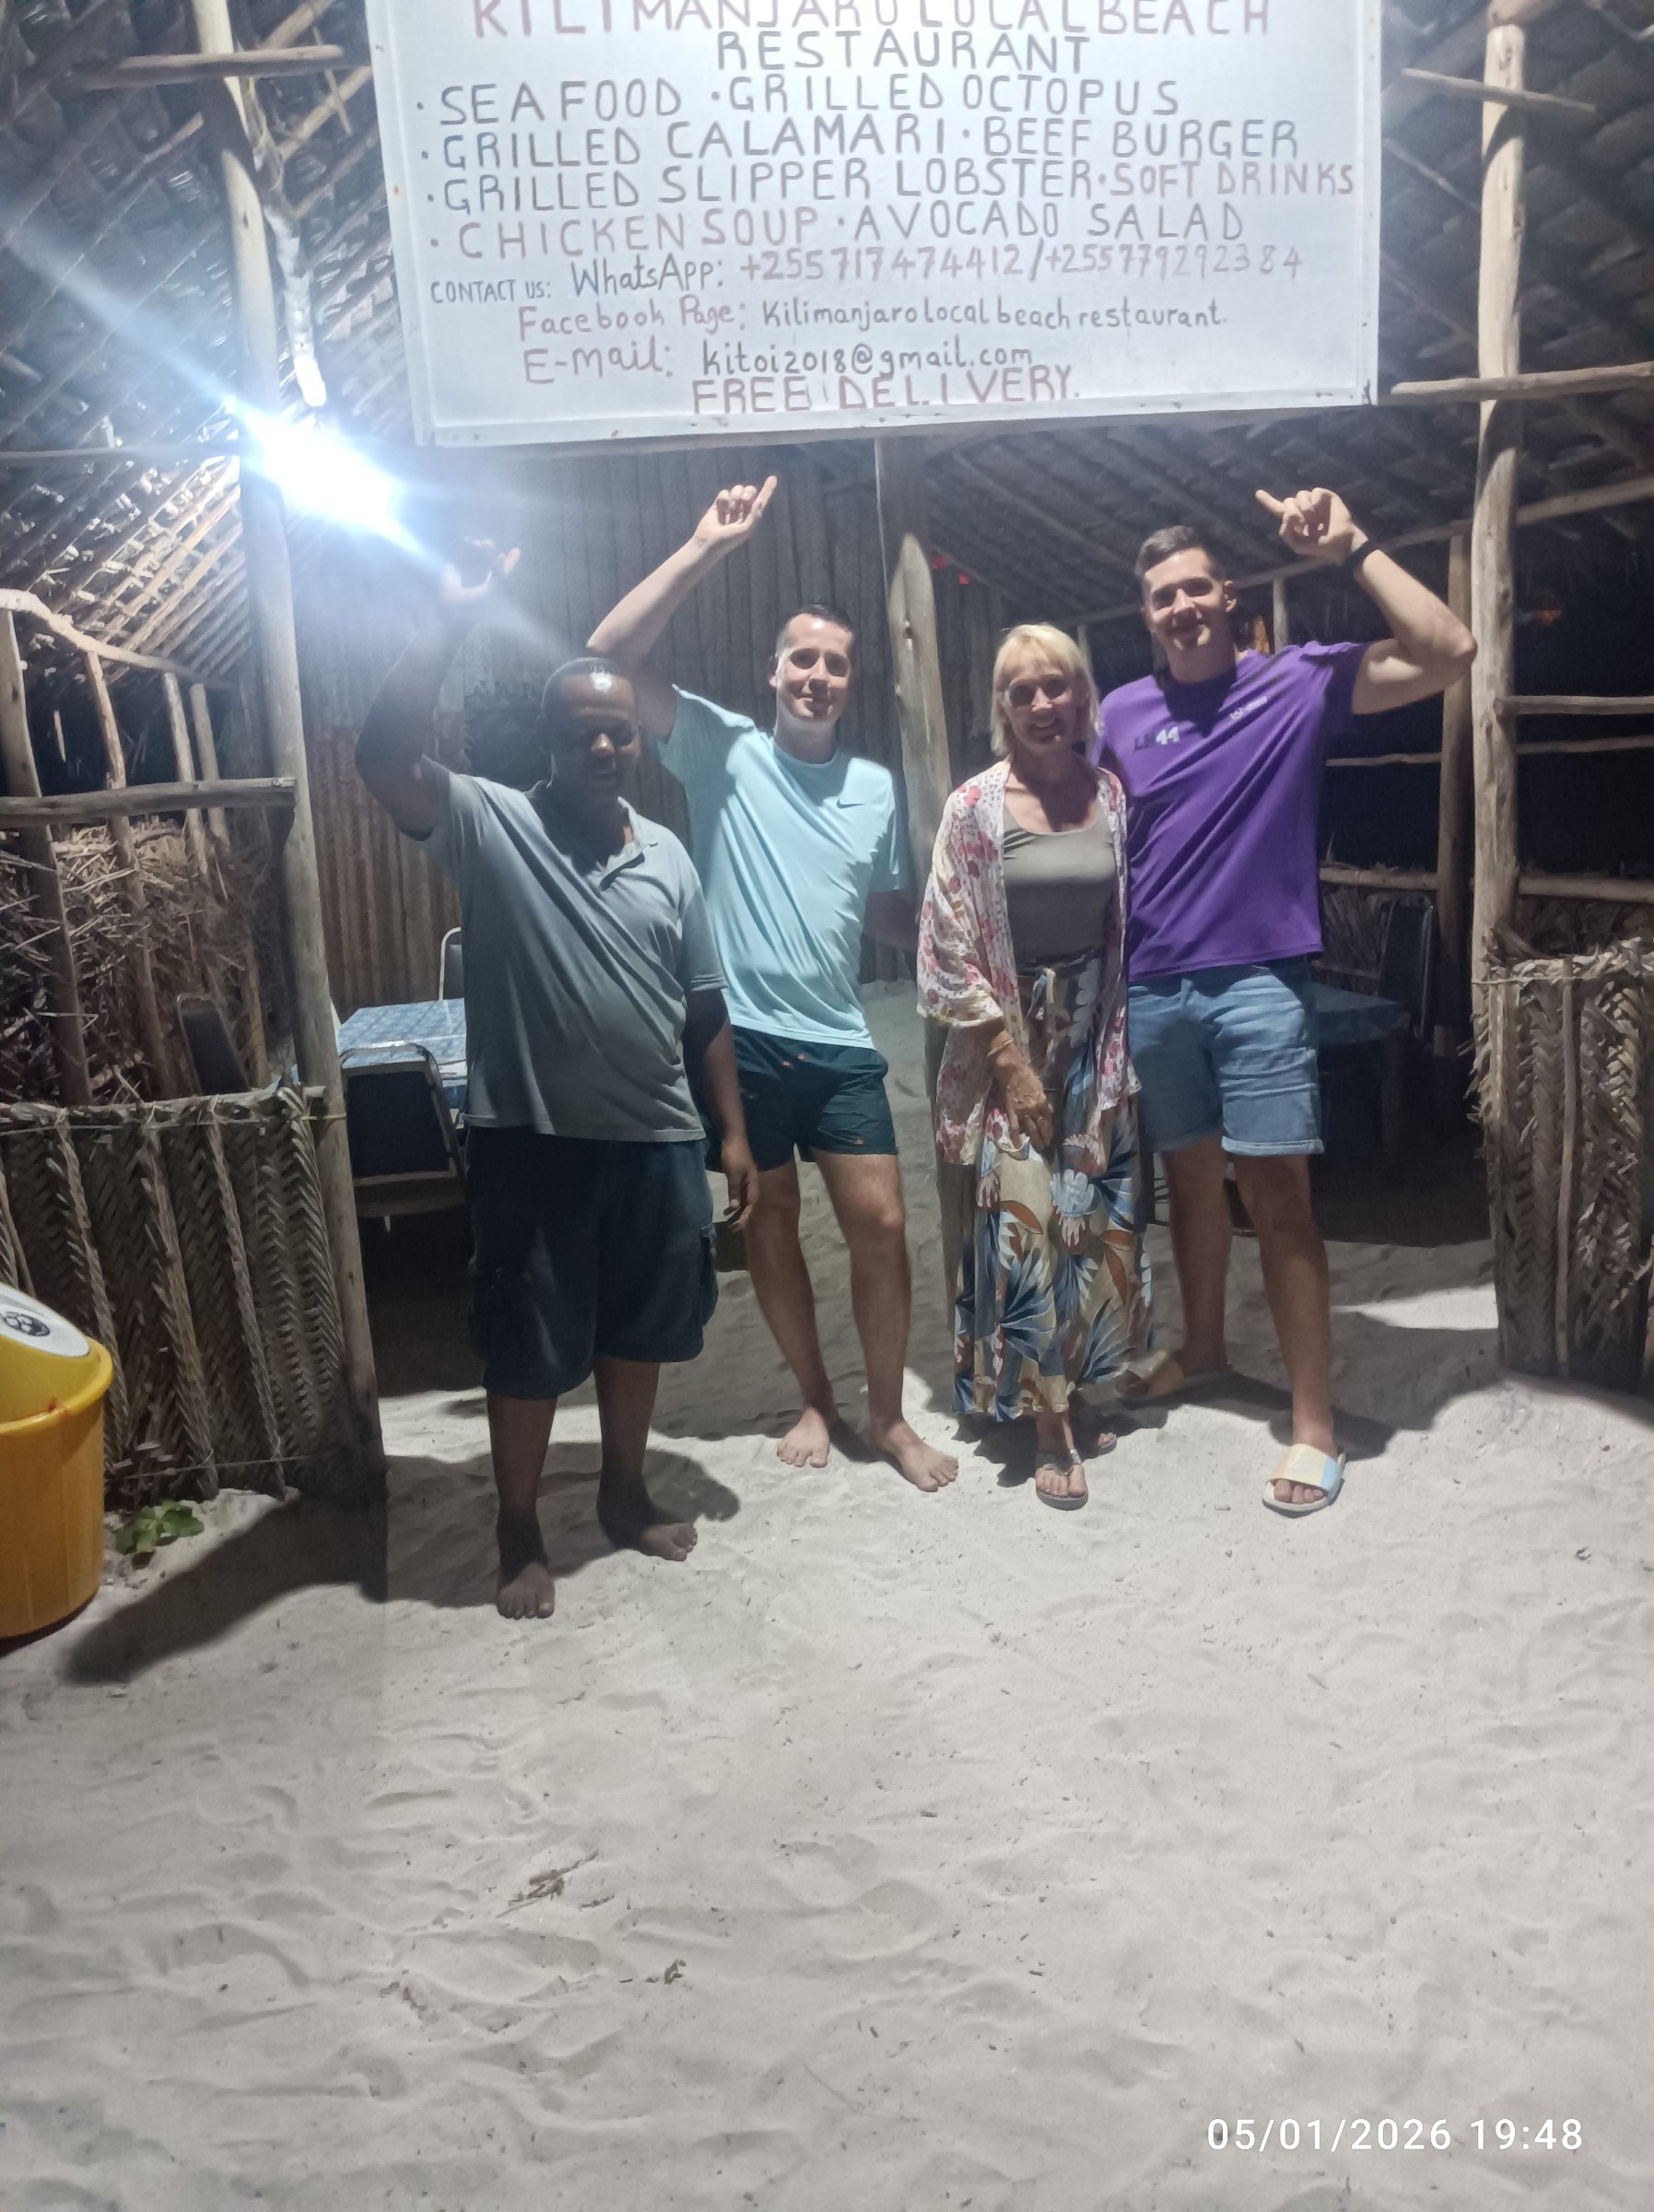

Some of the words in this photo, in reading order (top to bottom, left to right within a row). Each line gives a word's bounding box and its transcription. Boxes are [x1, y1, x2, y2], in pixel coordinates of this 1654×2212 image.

[718, 29, 1091, 73] RESTAURANT
[729, 73, 944, 113] GRILLED
[962, 74, 1179, 116] OCTOPUS
[443, 128, 640, 171] GRILLED
[667, 113, 944, 159] CALAMARI
[984, 116, 1092, 156] BEEF
[1111, 119, 1297, 159] BURGER
[444, 171, 639, 214] GRILLED
[659, 158, 871, 204] SLIPPER
[897, 158, 1092, 199] LOBSTER
[1109, 160, 1202, 197] SOFT
[1216, 161, 1355, 195] DRINKS
[459, 214, 685, 259] CHICKEN
[701, 207, 817, 246] SOUP
[854, 200, 1059, 240] AVOCADO
[1087, 202, 1243, 241] SALAD
[430, 279, 515, 304] CONTACT
[525, 280, 552, 300] US:
[518, 298, 664, 342] Facebook
[703, 334, 1032, 378] kitoi2018@gmail.com
[693, 376, 806, 415] FREE
